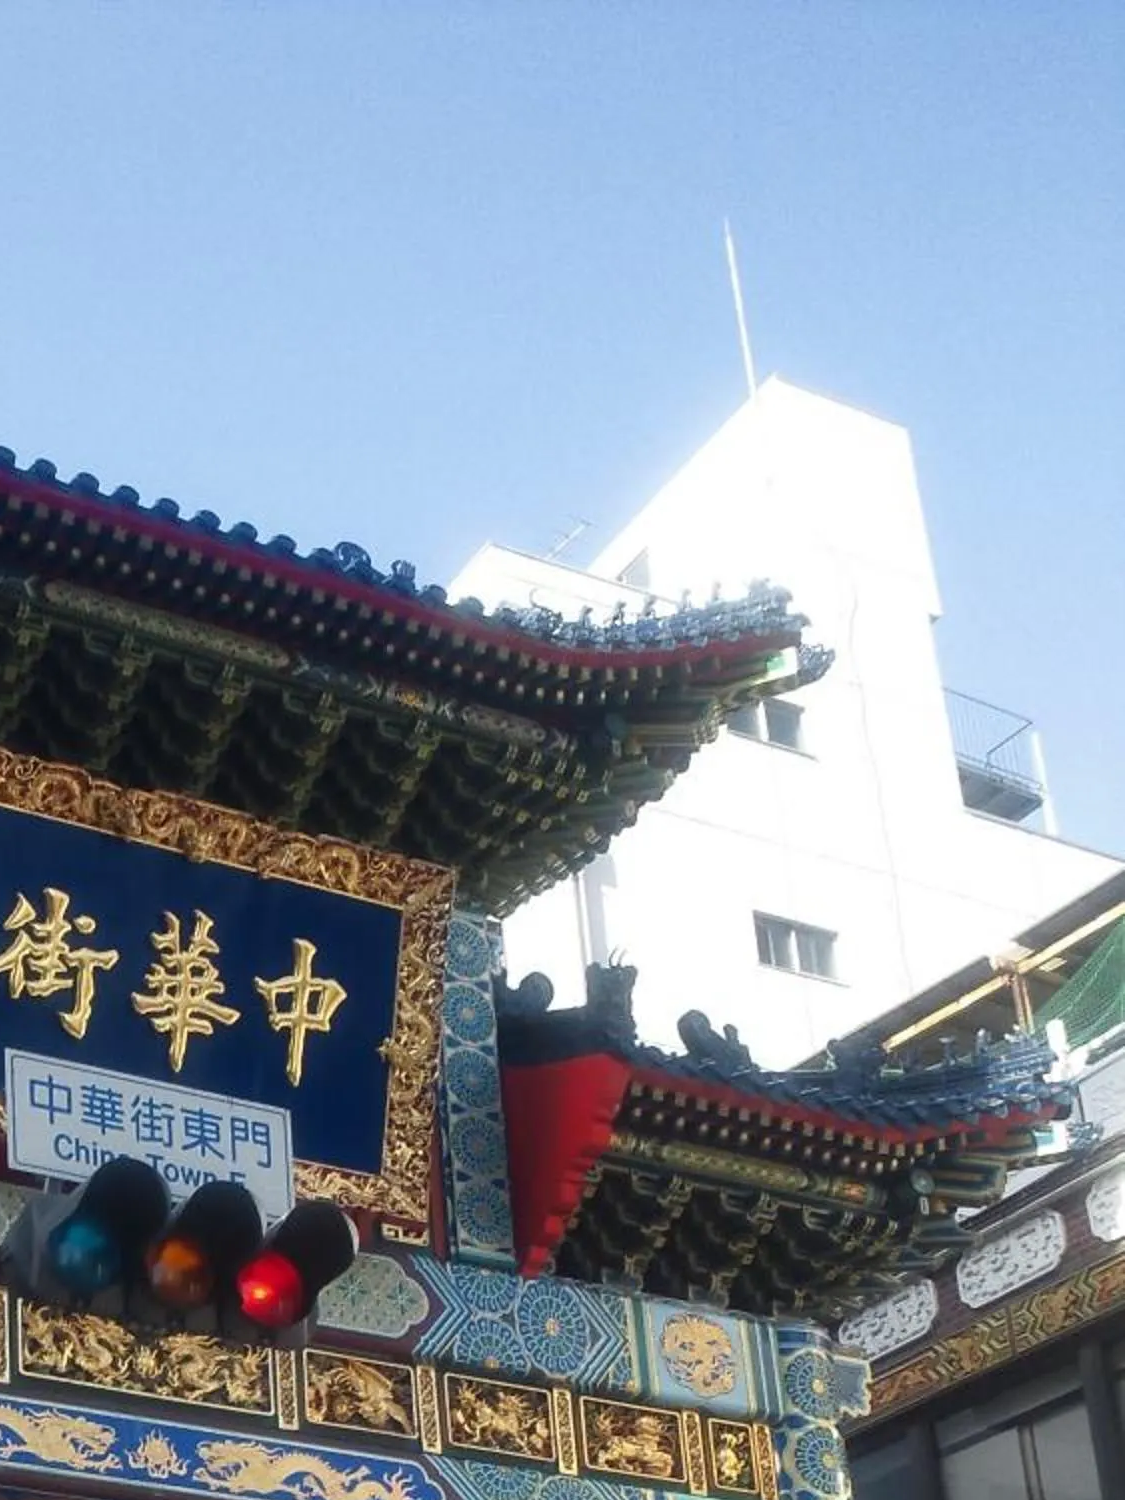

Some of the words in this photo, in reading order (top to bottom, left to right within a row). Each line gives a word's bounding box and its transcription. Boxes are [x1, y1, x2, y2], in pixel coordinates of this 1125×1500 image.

[29, 1074, 272, 1169] 中華街東門
[53, 1132, 131, 1166] Chin
